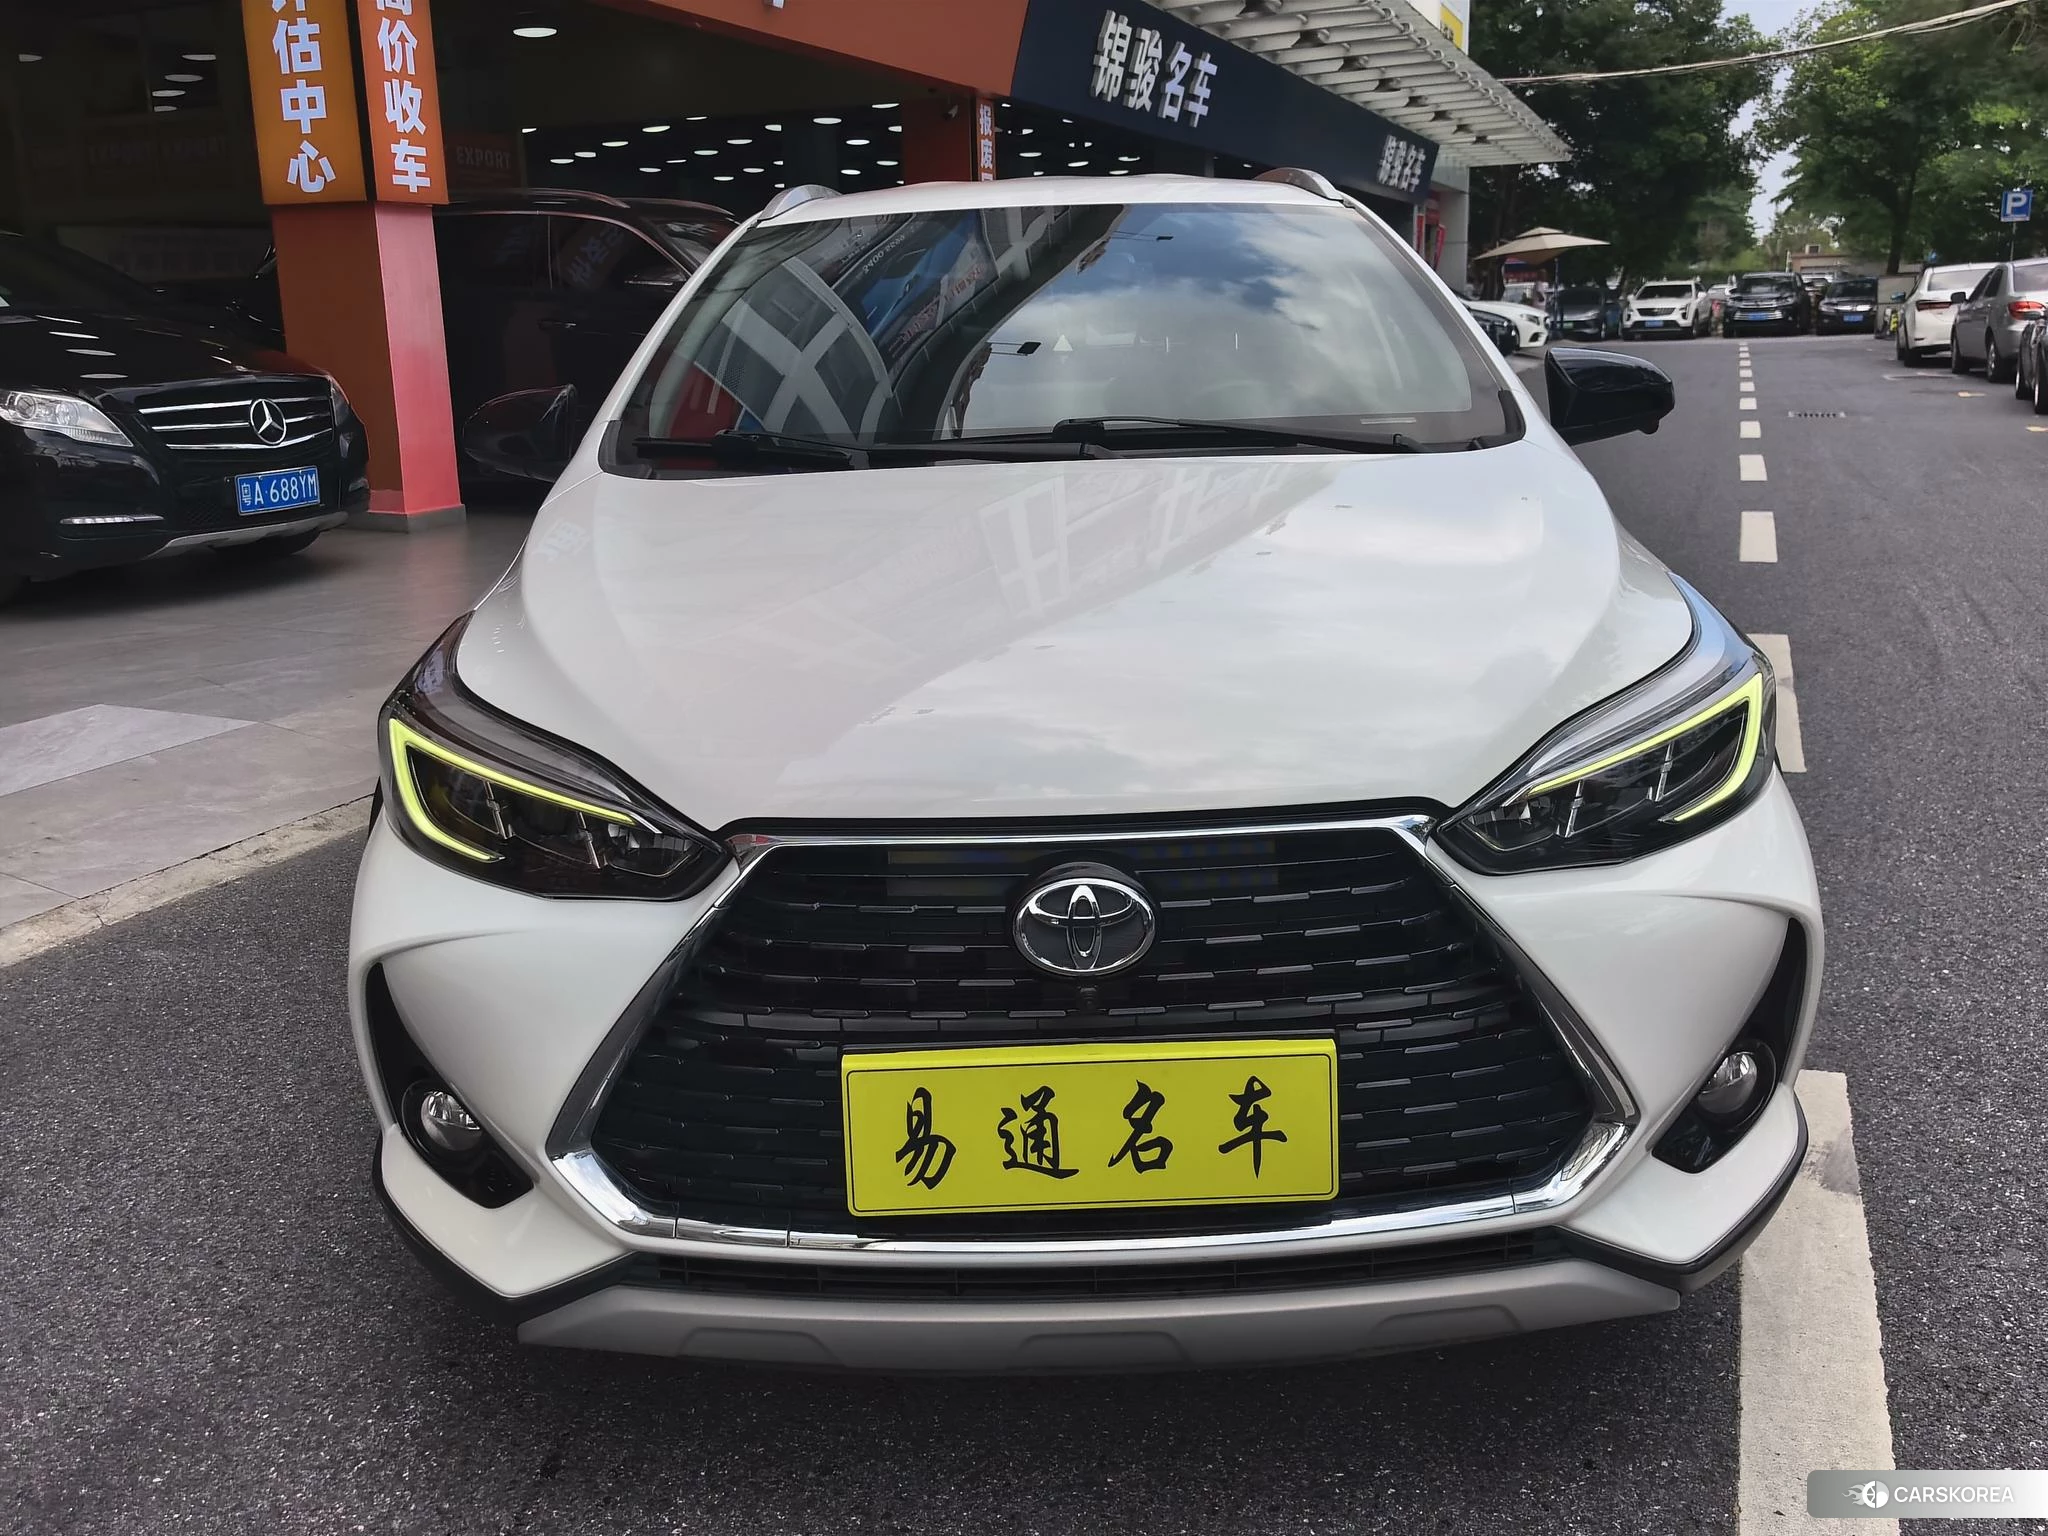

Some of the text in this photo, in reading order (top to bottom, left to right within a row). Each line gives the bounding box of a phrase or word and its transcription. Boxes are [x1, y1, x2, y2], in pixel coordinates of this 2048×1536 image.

[271, 0, 336, 193] 估中心
[376, 0, 431, 193] 价收车
[1091, 9, 1218, 128] 锦骏名车
[456, 146, 511, 168] EXPORT
[980, 104, 993, 180] 报废
[2006, 193, 2027, 214] P
[896, 1076, 1287, 1190] 易通名车
